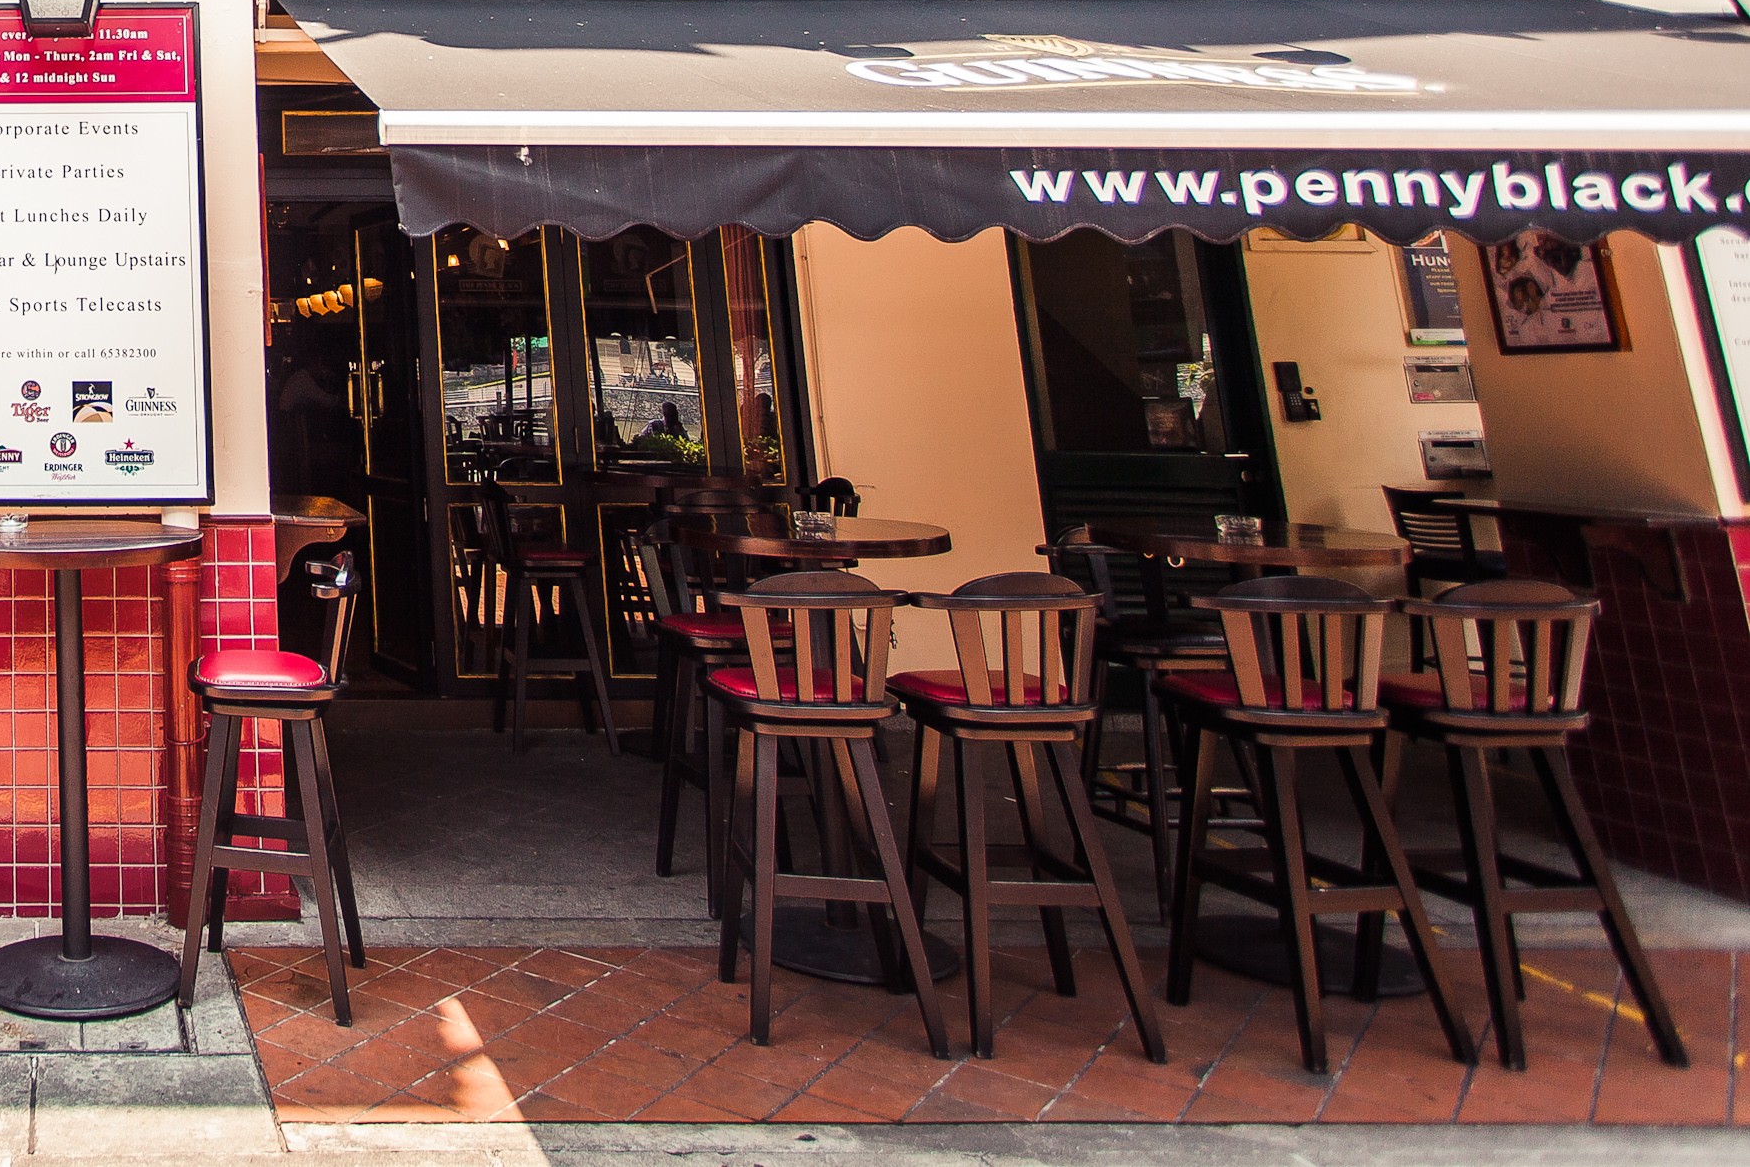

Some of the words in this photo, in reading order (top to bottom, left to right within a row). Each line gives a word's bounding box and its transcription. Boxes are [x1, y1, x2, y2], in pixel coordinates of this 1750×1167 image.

[98, 28, 148, 41] 11.30am
[3, 50, 31, 62] Mon
[43, 50, 86, 64] Thurs,
[88, 50, 114, 62] 2am
[118, 50, 138, 62] Fri
[141, 50, 153, 62] &
[156, 50, 181, 63] Sat,
[0, 73, 10, 84] &
[15, 73, 29, 84] 12
[33, 72, 89, 86] midnight
[92, 72, 116, 84] Sun
[79, 121, 140, 136] Events
[62, 165, 125, 180] Parties
[1006, 162, 1750, 220] www.pennyblack.
[14, 208, 90, 224] Lunches
[98, 207, 148, 226] Daily
[21, 252, 37, 268] &
[45, 252, 107, 271] Lounge
[115, 252, 186, 271] Upstairs
[9, 297, 68, 316] Sports
[76, 296, 162, 313] Telecasts
[17, 349, 54, 359] within
[58, 351, 70, 359] or
[74, 349, 96, 359] call
[100, 349, 157, 360] 65382300
[75, 392, 109, 402] STRONGBOW
[10, 402, 51, 423] Tiger
[125, 399, 177, 412] GUINNESS
[109, 453, 151, 462] Heineken
[44, 463, 83, 473] ERDINGER
